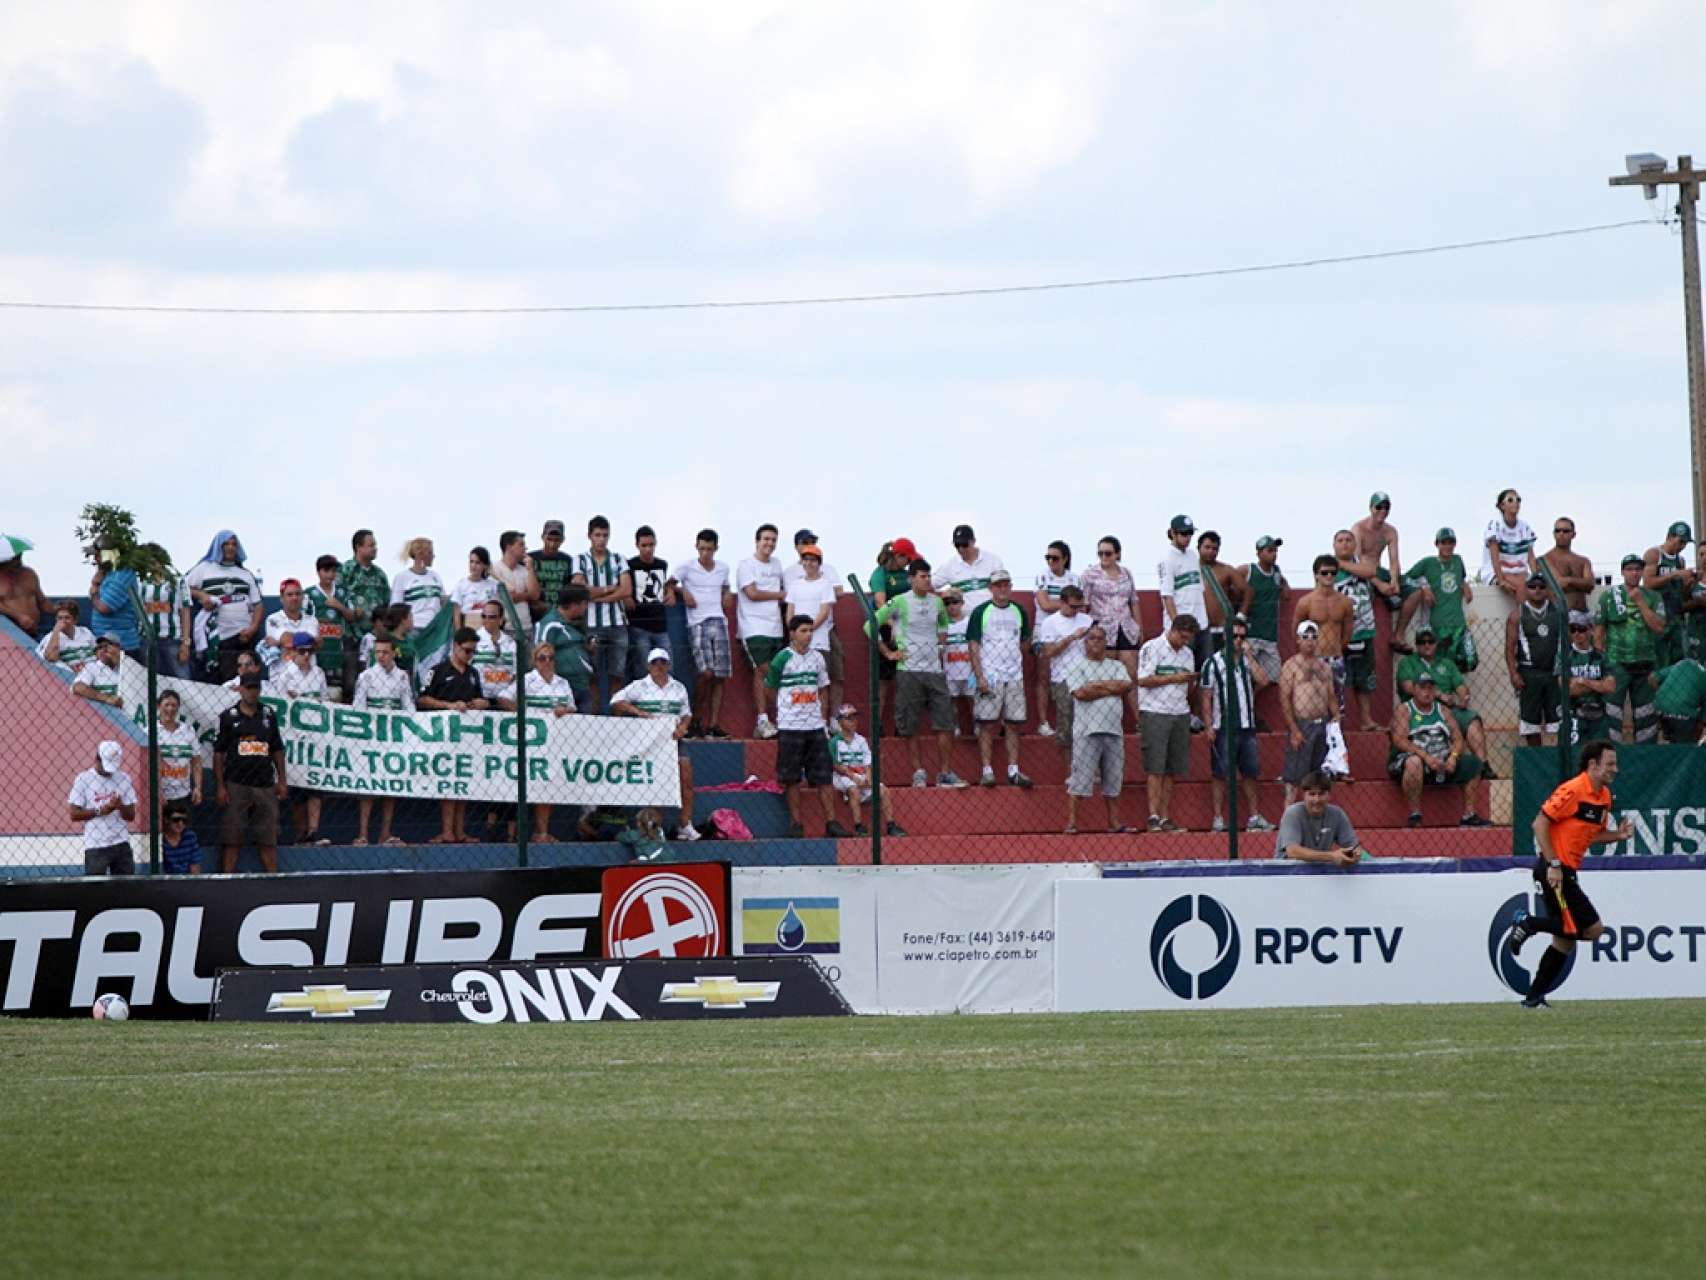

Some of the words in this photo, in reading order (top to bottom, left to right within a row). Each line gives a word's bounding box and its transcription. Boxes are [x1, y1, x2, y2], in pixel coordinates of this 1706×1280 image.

[362, 750, 474, 778] TORCE
[484, 754, 550, 783] POR
[562, 755, 654, 785] VOCÊ!
[307, 771, 414, 793] SARANDI
[437, 780, 469, 795] PR
[903, 932, 966, 946] Fone/Fax:
[968, 931, 994, 946] (44)
[903, 949, 1038, 962] www.ciapetro.com.br
[420, 989, 489, 1003] Chevrolet
[451, 966, 642, 1024] ONIX
